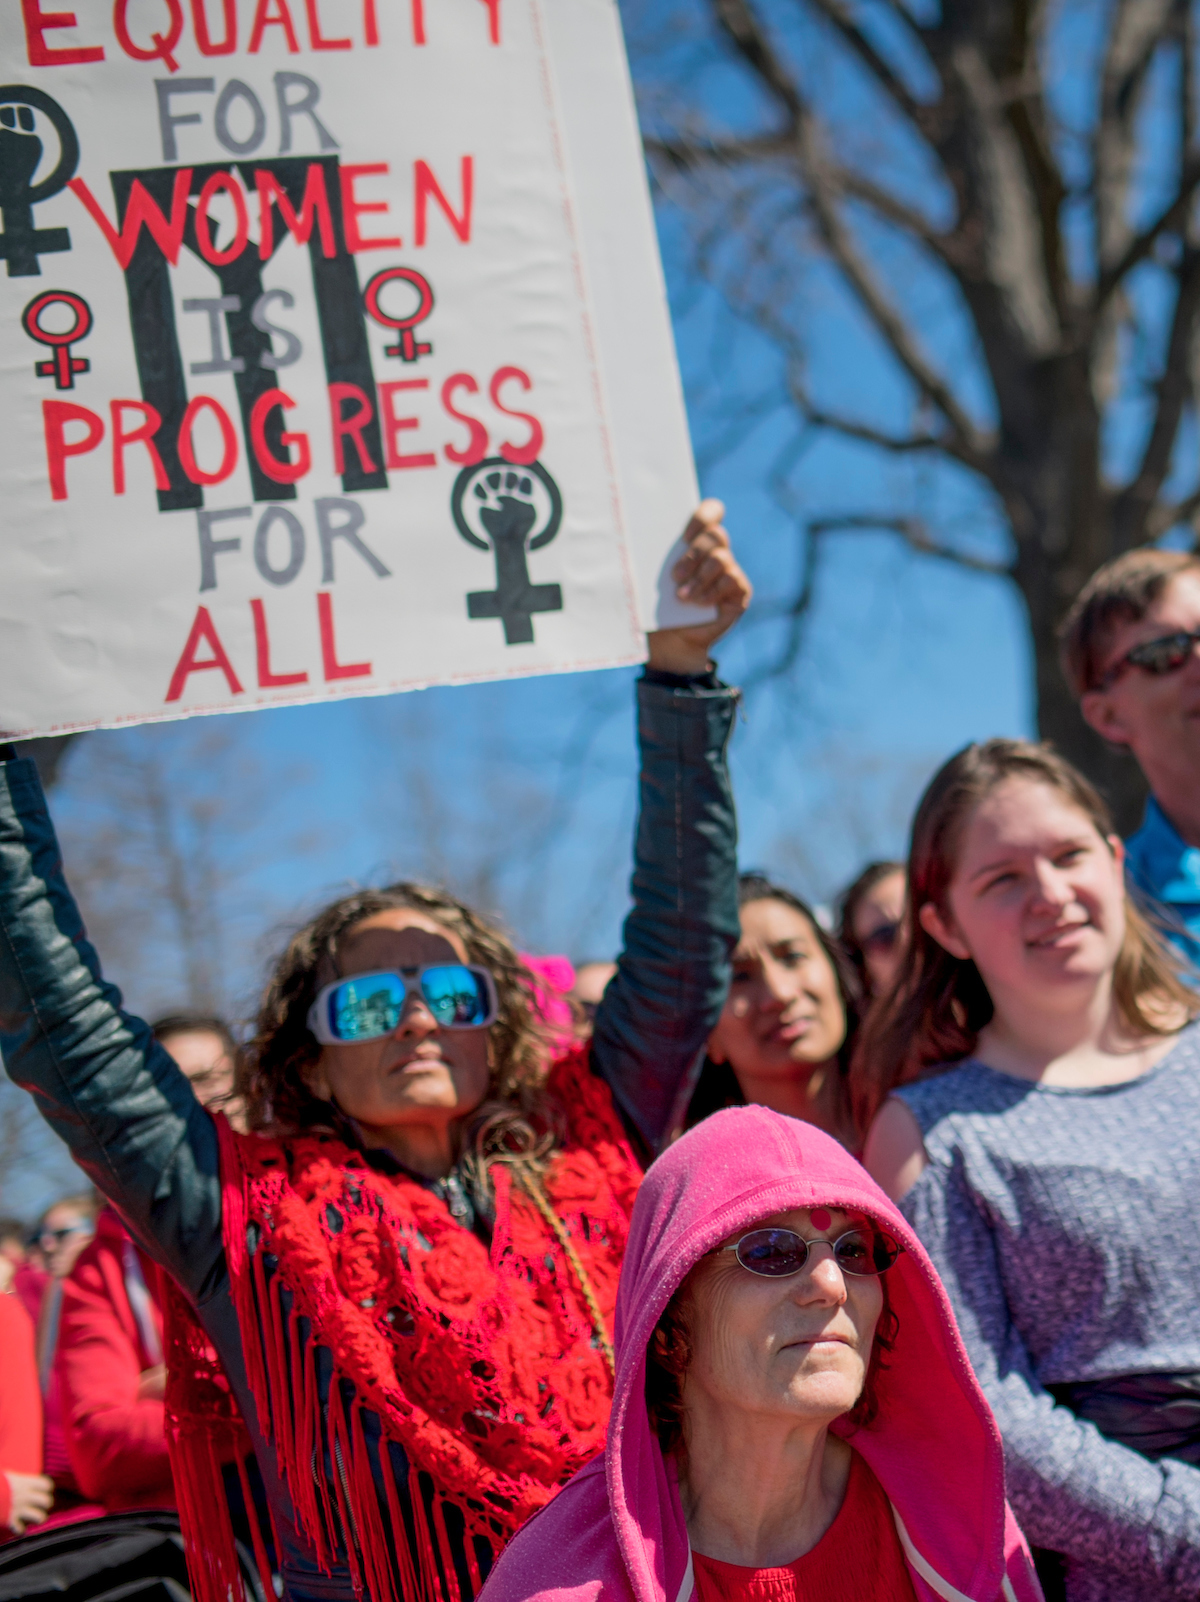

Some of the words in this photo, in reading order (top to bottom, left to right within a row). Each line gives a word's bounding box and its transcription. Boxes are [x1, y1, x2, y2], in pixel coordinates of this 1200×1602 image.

[154, 71, 341, 162] FOR
[66, 155, 474, 271] WOMEN
[182, 289, 303, 376] IS
[42, 366, 544, 501] PROGRESS
[198, 498, 392, 593] FOR
[165, 592, 372, 703] ALL
